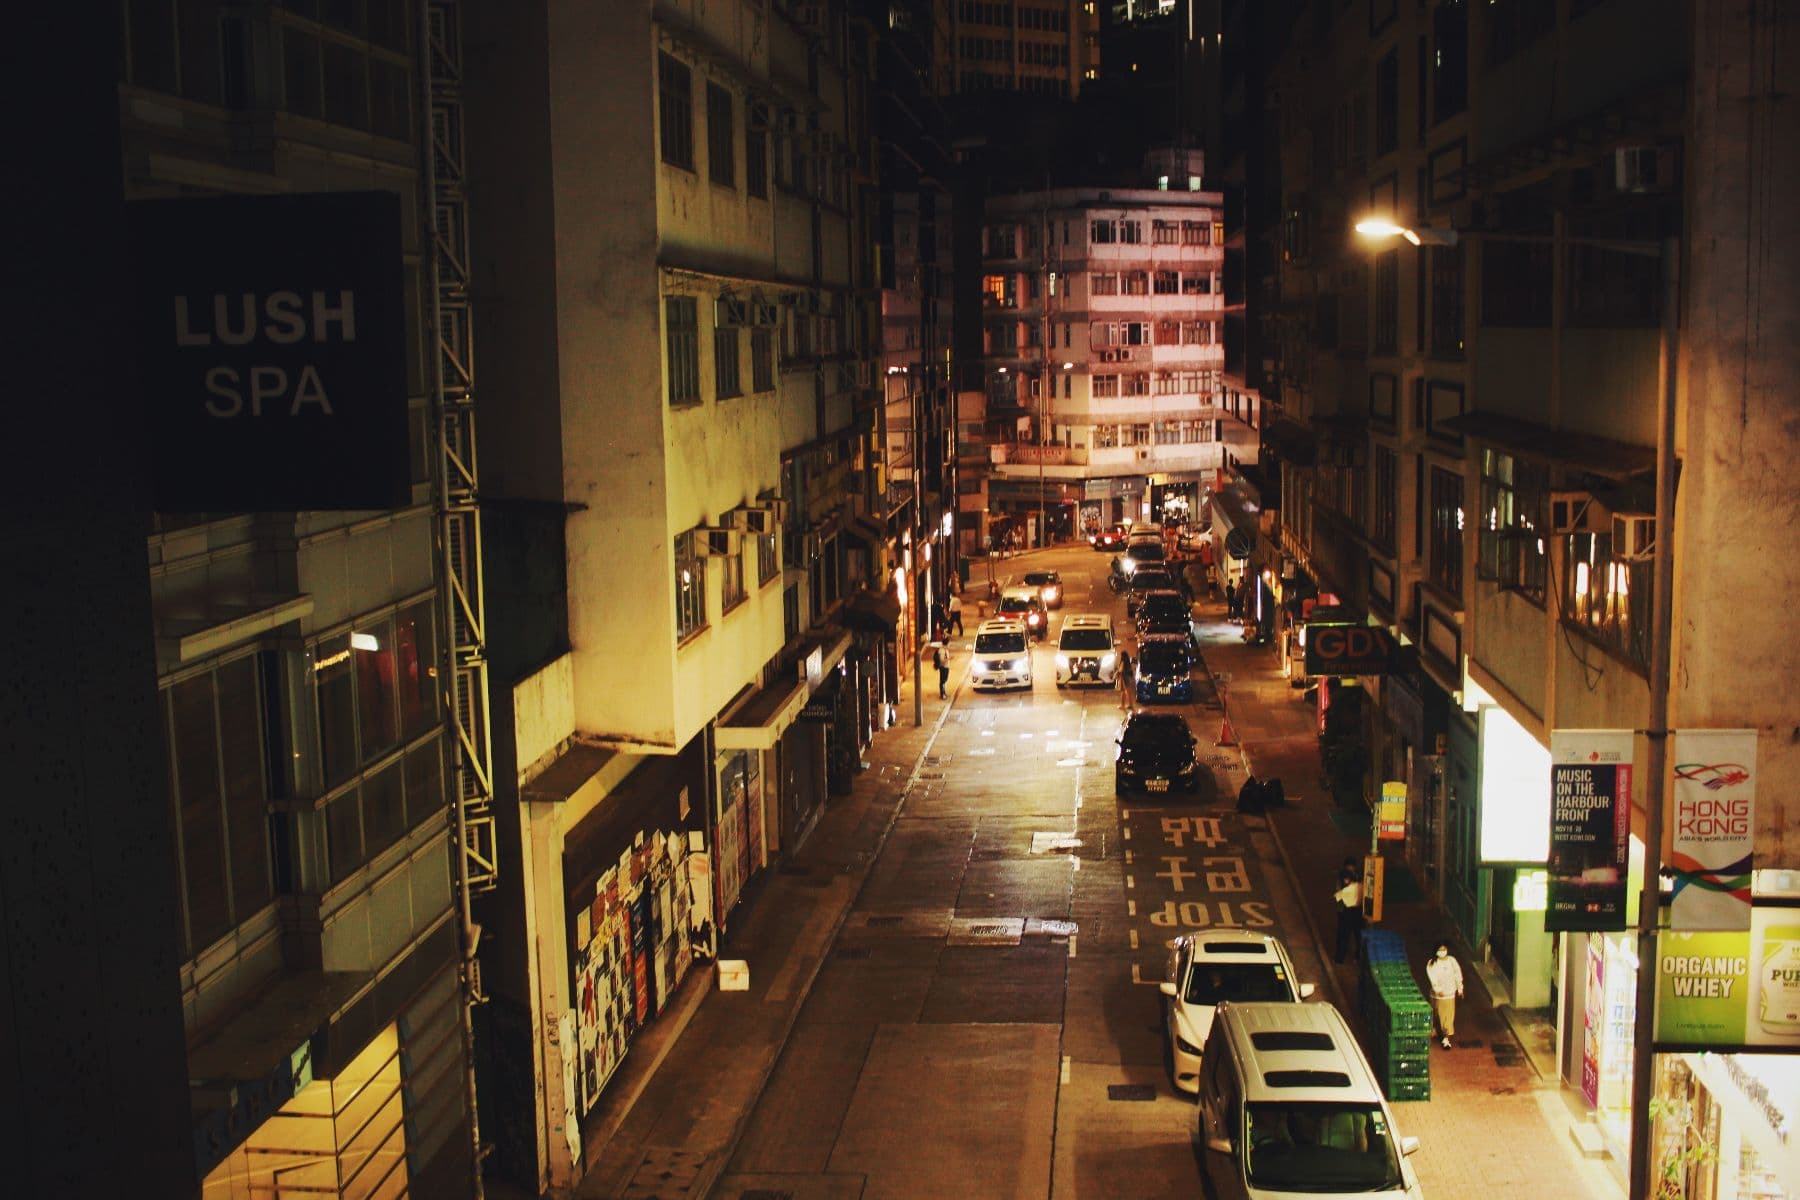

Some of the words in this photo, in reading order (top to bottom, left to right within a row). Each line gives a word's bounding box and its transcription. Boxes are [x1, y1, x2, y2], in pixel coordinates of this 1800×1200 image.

[174, 289, 357, 347] LUSH
[204, 365, 334, 418] SPA
[1557, 769, 1592, 783] MUSIC
[1556, 783, 1572, 796] ON
[1575, 783, 1595, 796] THE
[1555, 809, 1591, 822] FRONT
[1679, 799, 1749, 817] HONG
[1160, 816, 1229, 848] 站
[1678, 817, 1749, 836] KONG
[1155, 856, 1253, 893] 巴士
[1149, 900, 1275, 927] STOP
[1662, 956, 1747, 976] ORGANIC
[1672, 976, 1735, 998] WHEY
